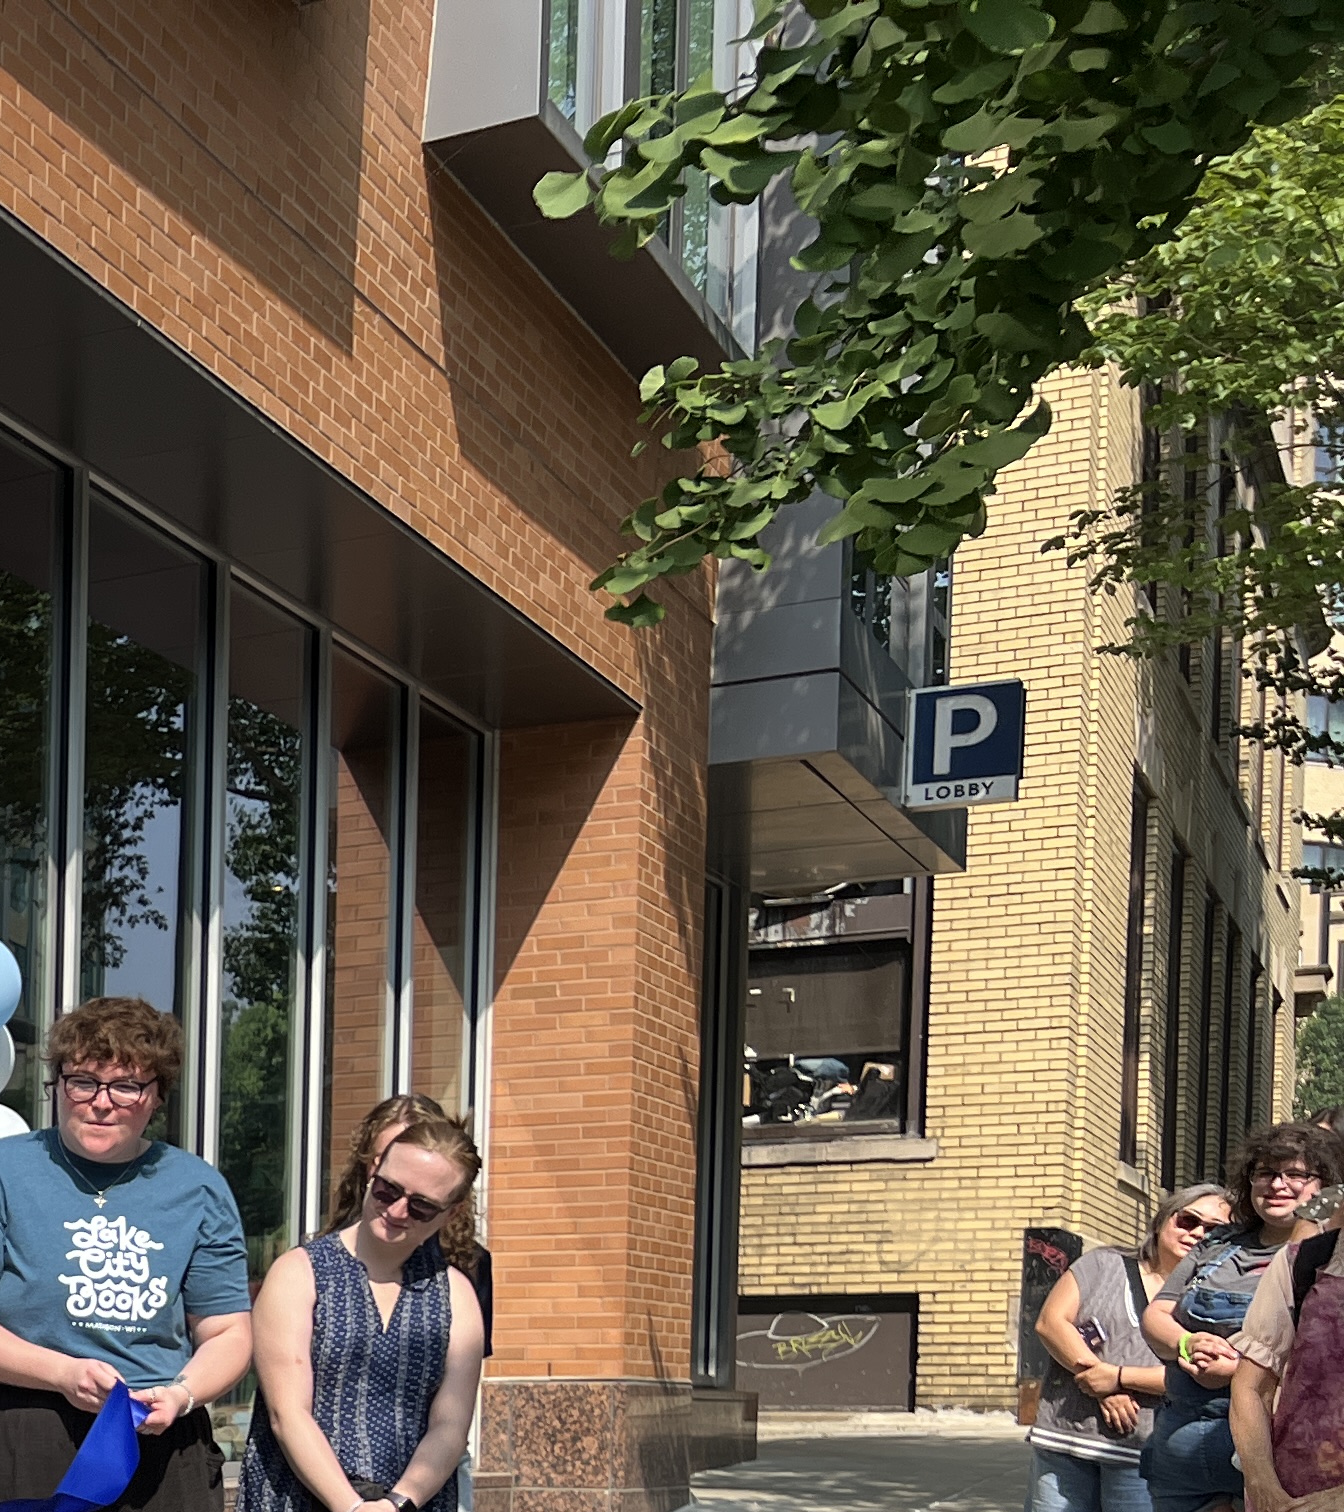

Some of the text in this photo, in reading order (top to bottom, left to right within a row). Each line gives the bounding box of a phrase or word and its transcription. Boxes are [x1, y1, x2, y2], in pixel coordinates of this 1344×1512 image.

[933, 694, 998, 775] P
[924, 781, 994, 801] LOBBY
[63, 1215, 164, 1255] Lake
[65, 1248, 150, 1284] City
